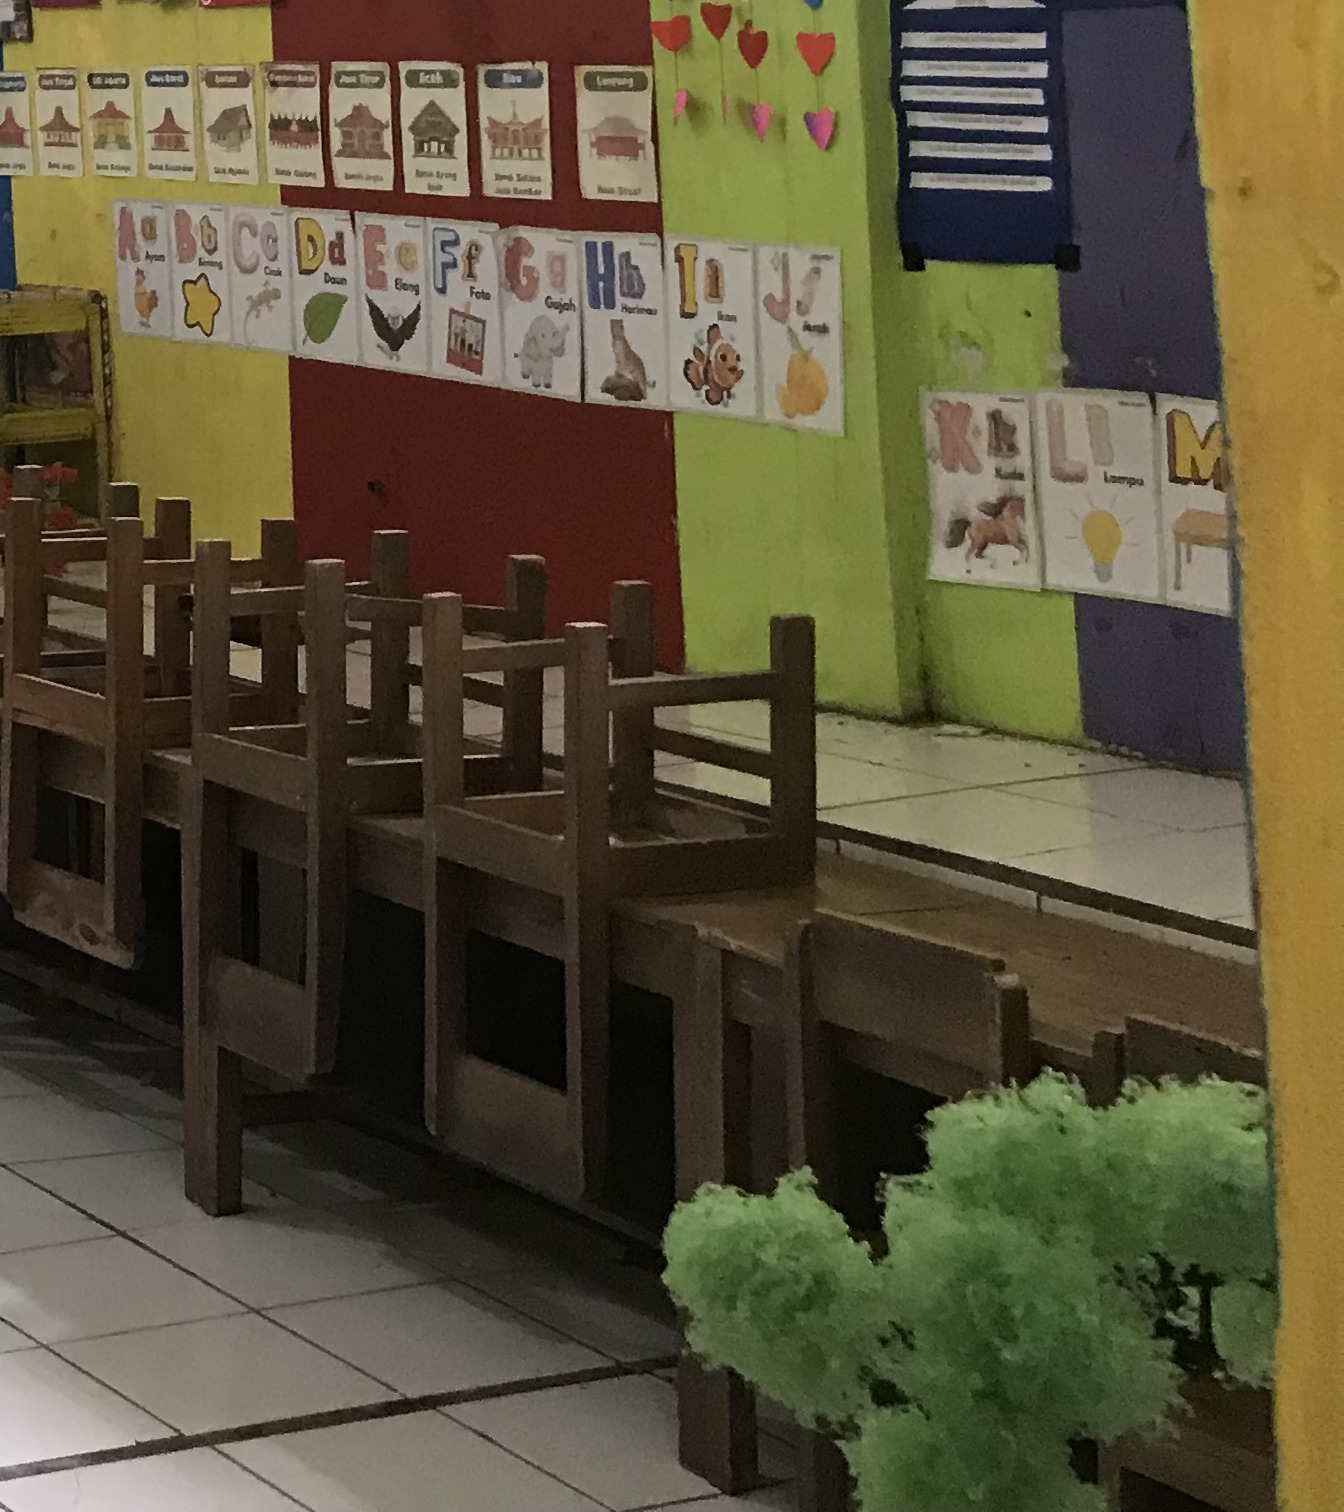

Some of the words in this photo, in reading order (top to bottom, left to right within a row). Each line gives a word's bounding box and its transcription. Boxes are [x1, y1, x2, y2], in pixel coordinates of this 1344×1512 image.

[144, 250, 166, 263] Ayam
[324, 272, 348, 286] Daun
[394, 277, 420, 296] Elang
[469, 286, 492, 301] Foto
[544, 295, 576, 314] Gajah
[1103, 469, 1145, 488] Lampu
